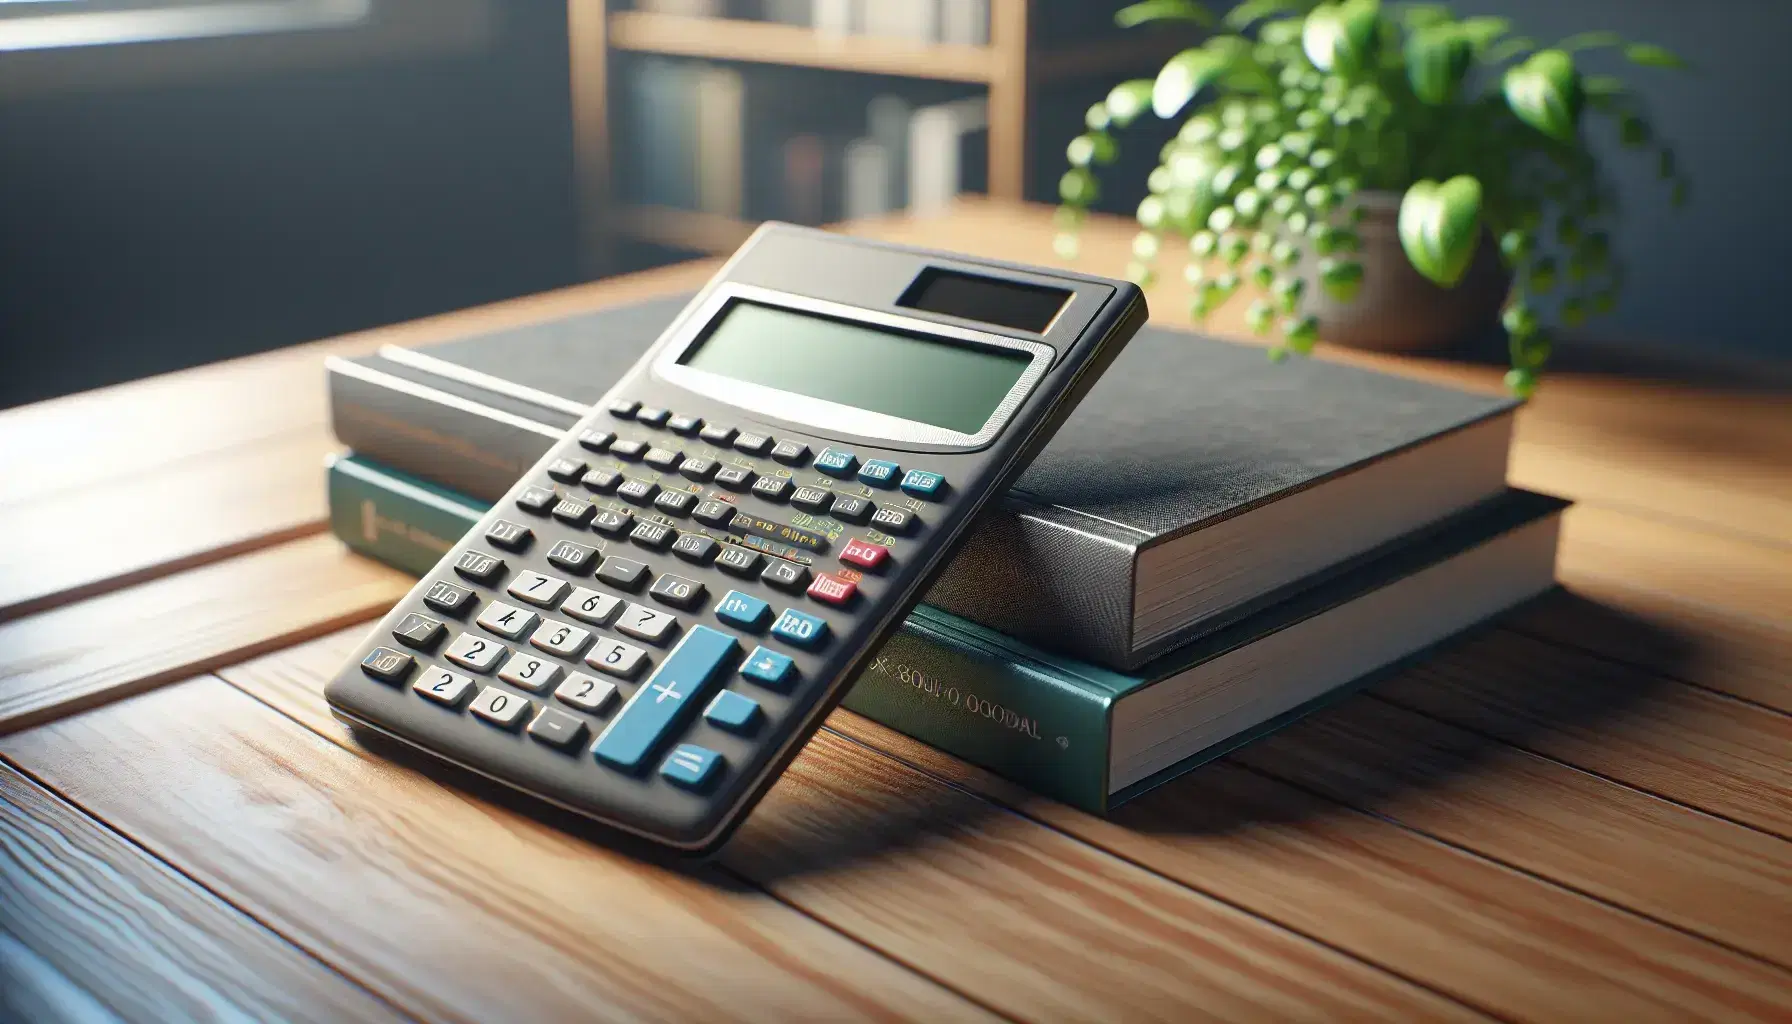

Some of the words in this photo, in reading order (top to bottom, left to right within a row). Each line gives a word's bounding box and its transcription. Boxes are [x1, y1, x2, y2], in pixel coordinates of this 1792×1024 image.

[528, 577, 548, 592] 7
[463, 641, 486, 660] 2
[605, 645, 626, 664] 5
[431, 673, 453, 692] 2
[575, 680, 595, 698] 2
